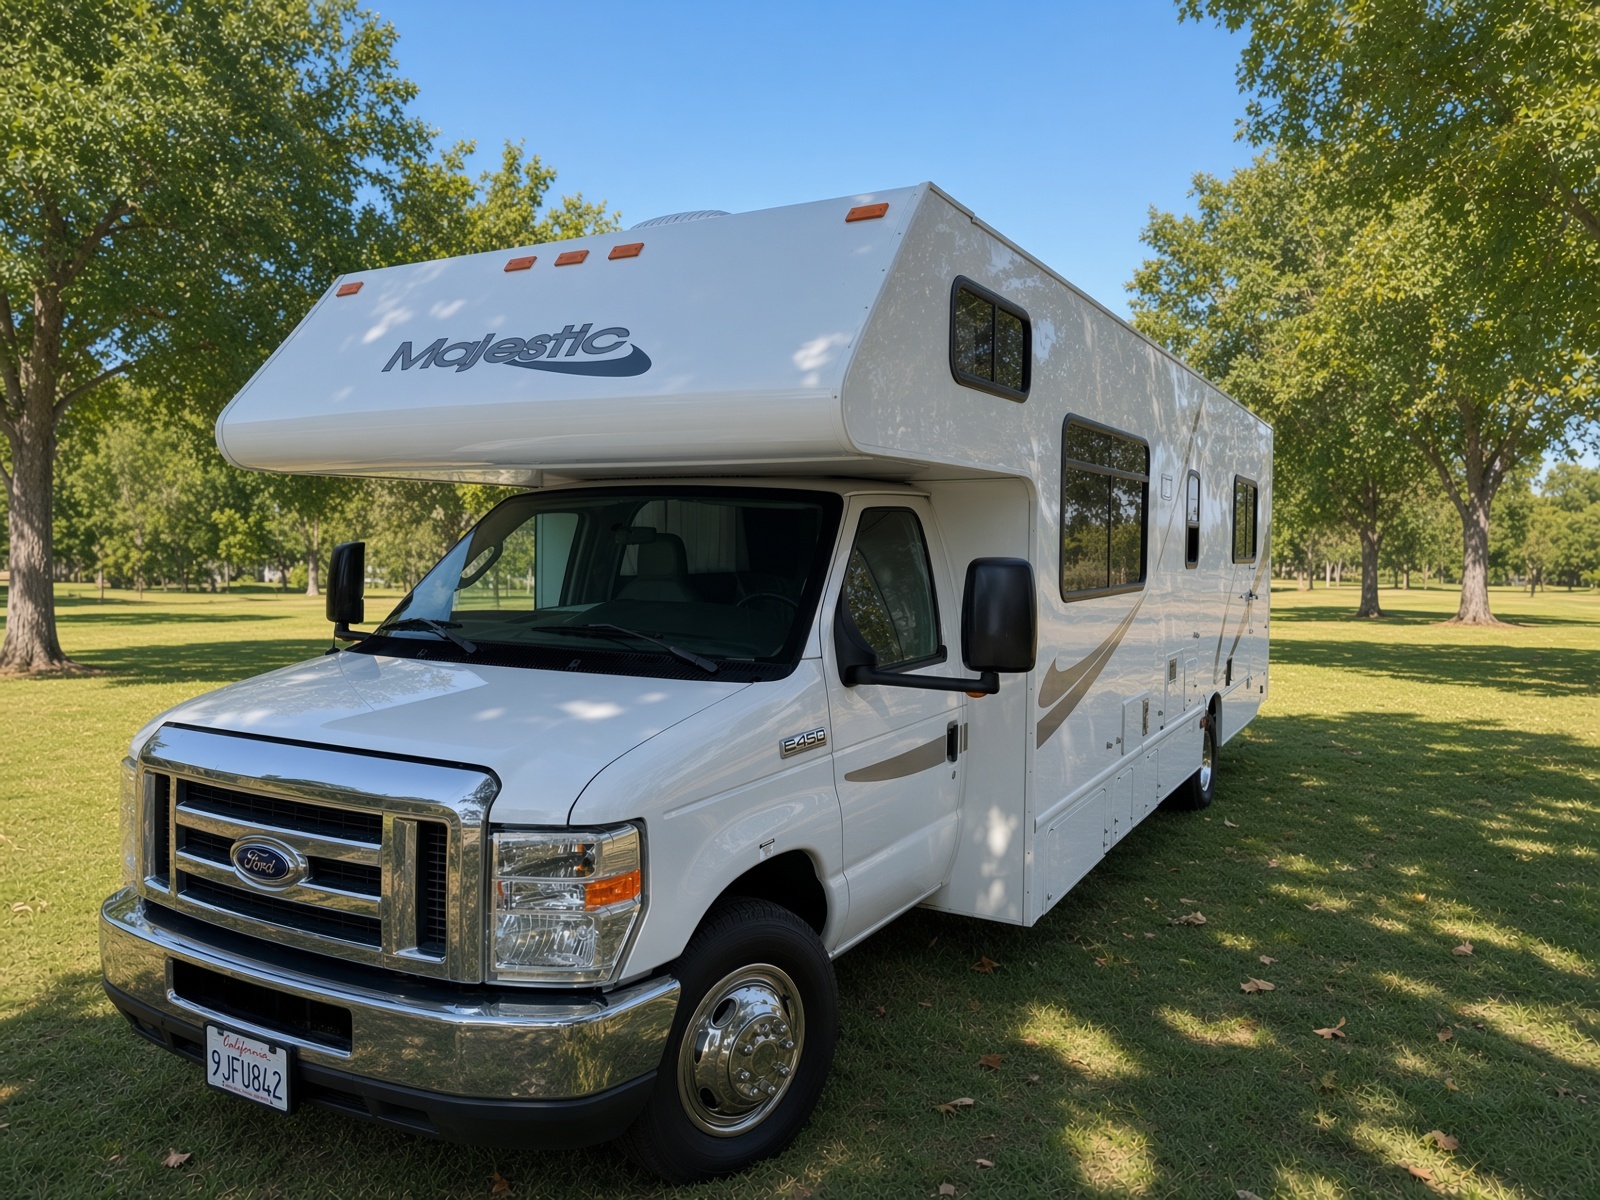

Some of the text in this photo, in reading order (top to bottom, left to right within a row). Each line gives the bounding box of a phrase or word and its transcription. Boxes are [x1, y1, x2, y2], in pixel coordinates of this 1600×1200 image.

[381, 323, 630, 373] Majestic
[244, 849, 276, 874] Ford
[223, 1034, 271, 1061] California
[212, 1049, 283, 1101] 9JFU842
